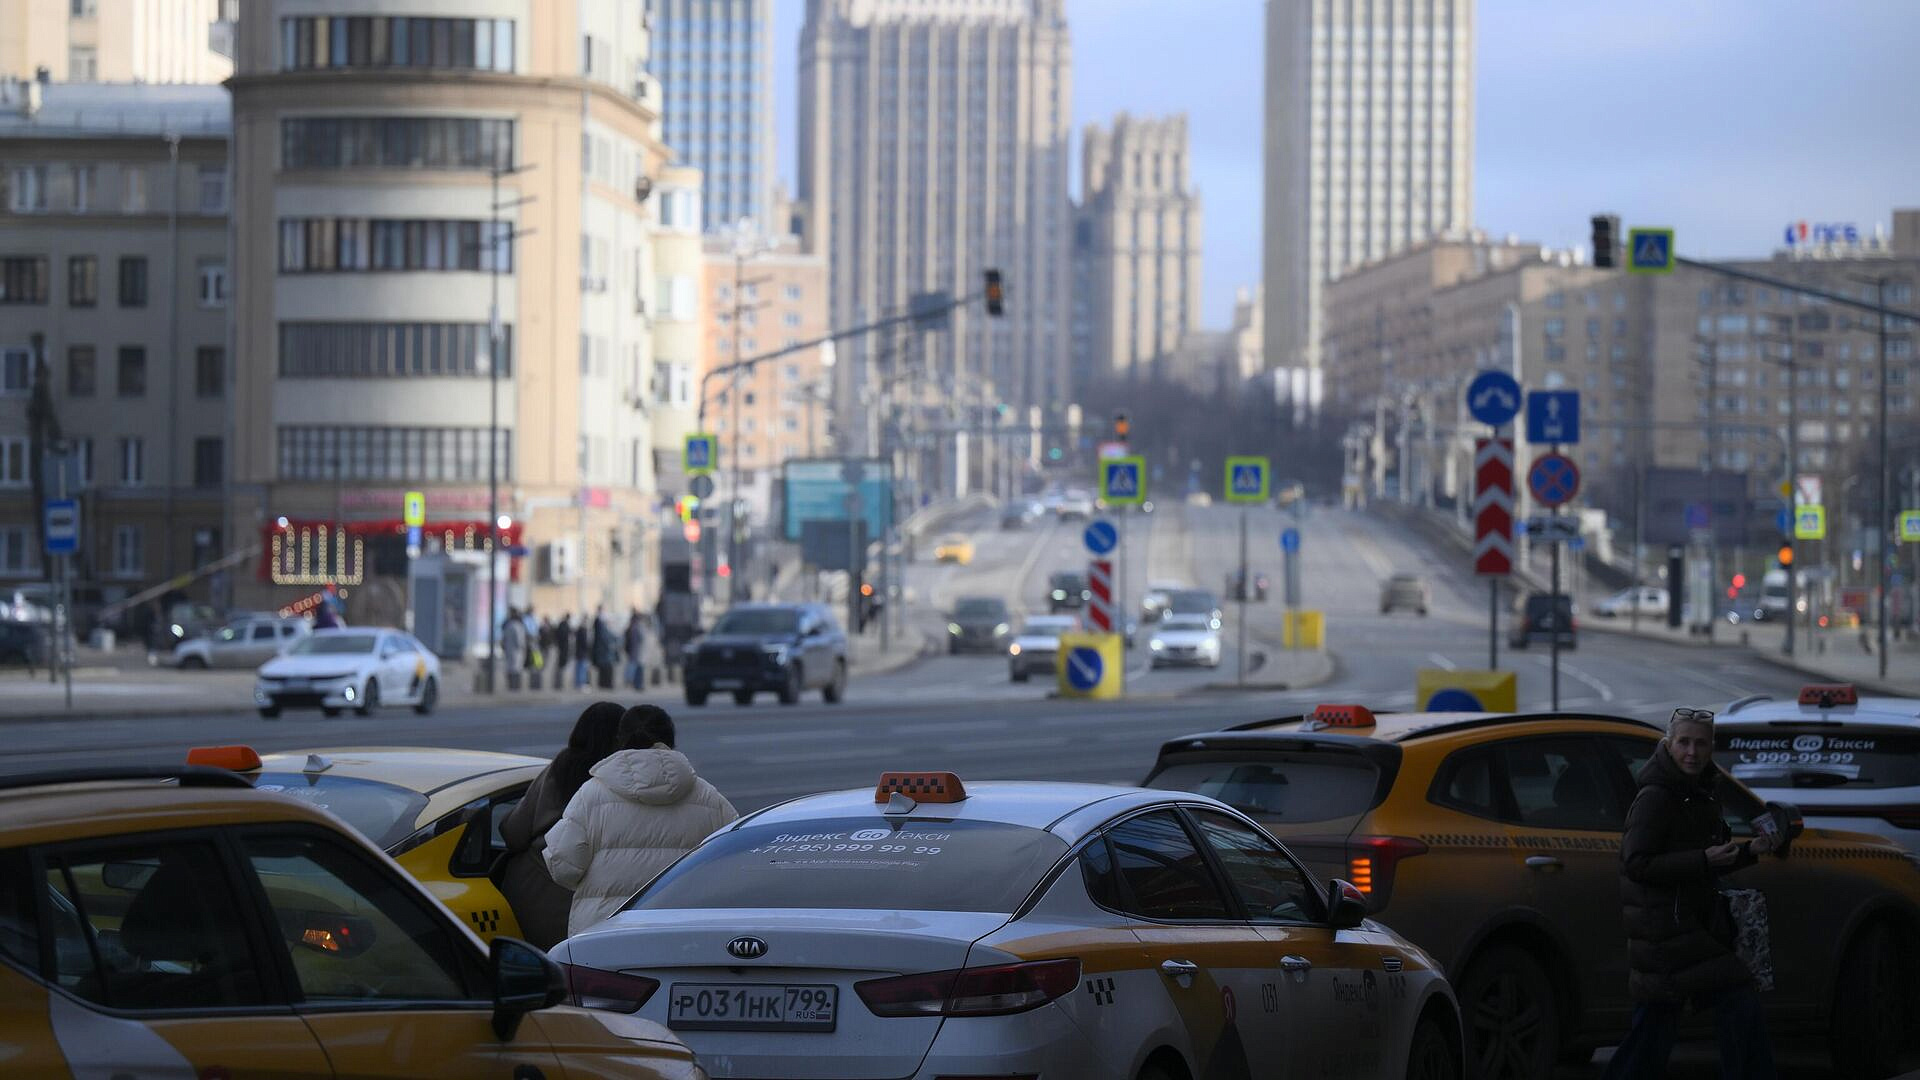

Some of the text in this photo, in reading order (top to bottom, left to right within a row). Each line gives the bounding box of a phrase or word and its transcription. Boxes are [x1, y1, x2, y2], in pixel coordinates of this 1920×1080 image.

[1729, 738, 1789, 749] Яндекс
[1827, 738, 1875, 749] Такси
[1756, 752, 1853, 763] 999-99-99
[771, 832, 848, 844] Яндекс
[894, 830, 950, 841] Такси
[878, 844, 906, 854] 99
[913, 846, 942, 855] 99
[733, 941, 760, 954] KIA
[787, 990, 827, 1011] 799
[1262, 984, 1279, 1013] 031
[796, 1011, 815, 1019] RUS
